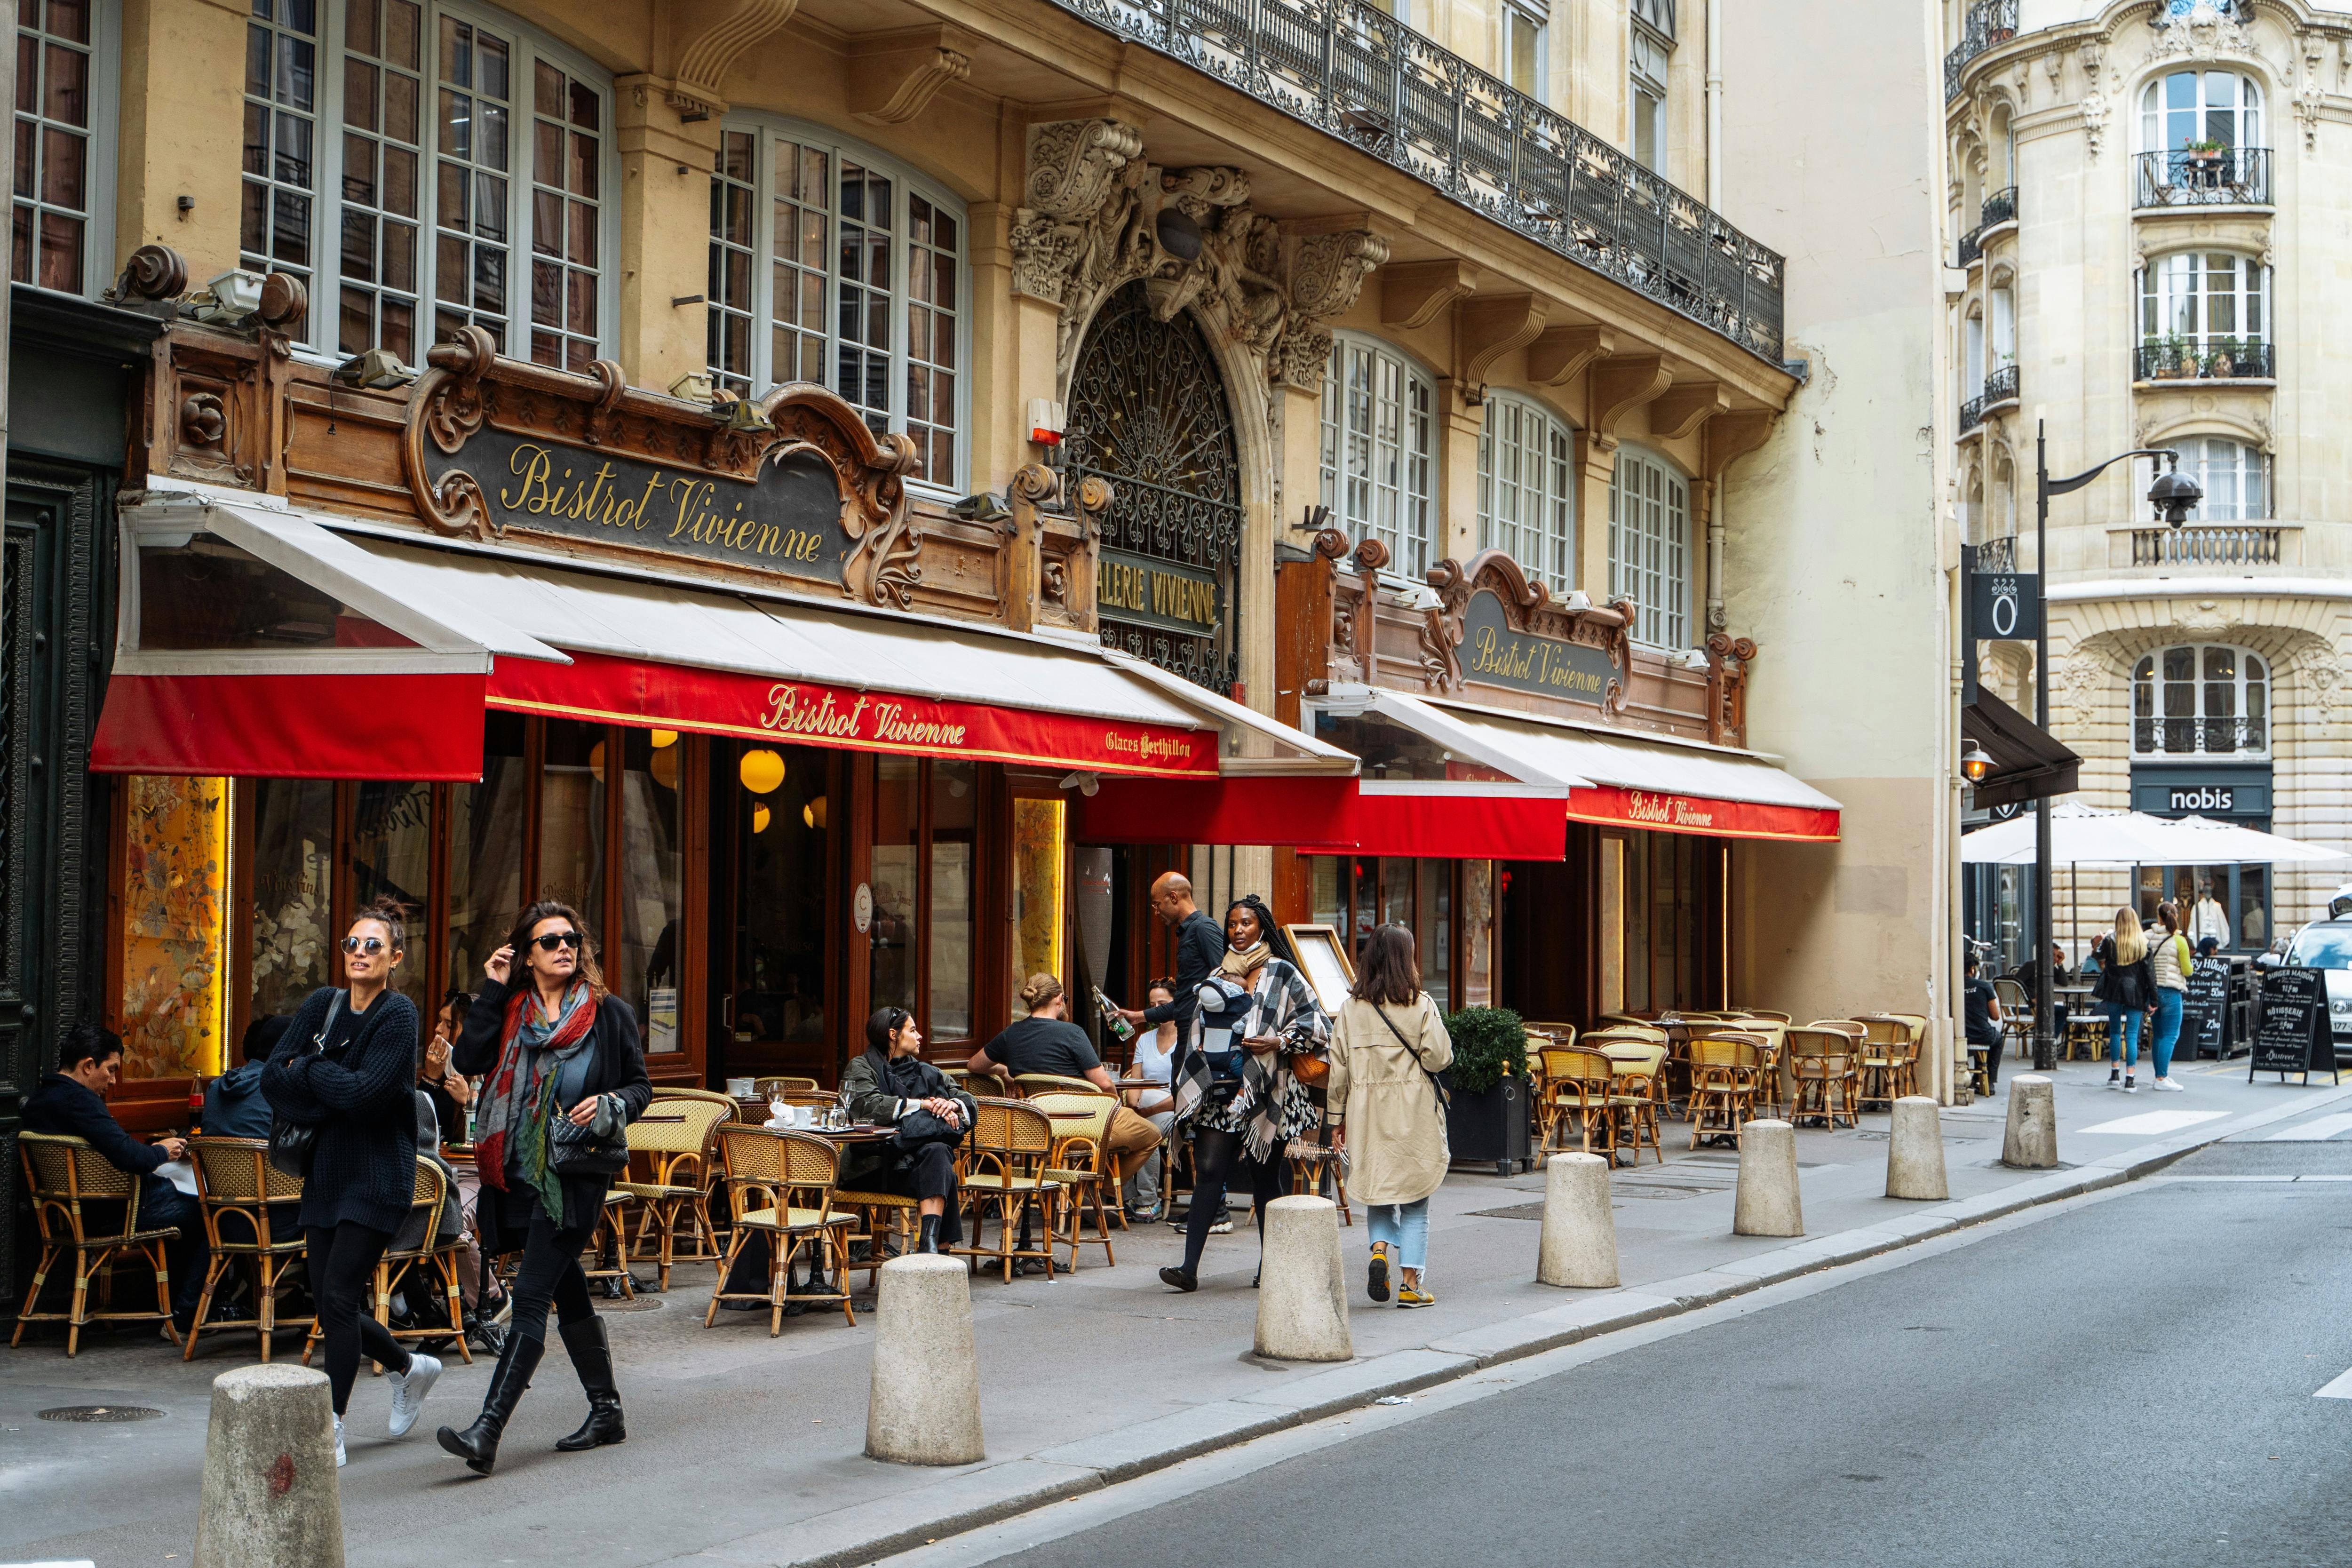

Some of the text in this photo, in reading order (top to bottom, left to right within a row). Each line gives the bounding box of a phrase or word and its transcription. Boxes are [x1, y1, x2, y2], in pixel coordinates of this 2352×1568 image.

[500, 444, 823, 564] Bistrot Vivienne
[1152, 570, 1216, 625] VIVIENNE
[1472, 626, 1601, 694] Bistrot Vivienne
[760, 684, 966, 746] Bistrot Vivienne
[1105, 731, 1191, 762] Glaces Berthillon
[1629, 790, 1712, 827] Bistrot Vivienne
[2171, 788, 2232, 810] nobis
